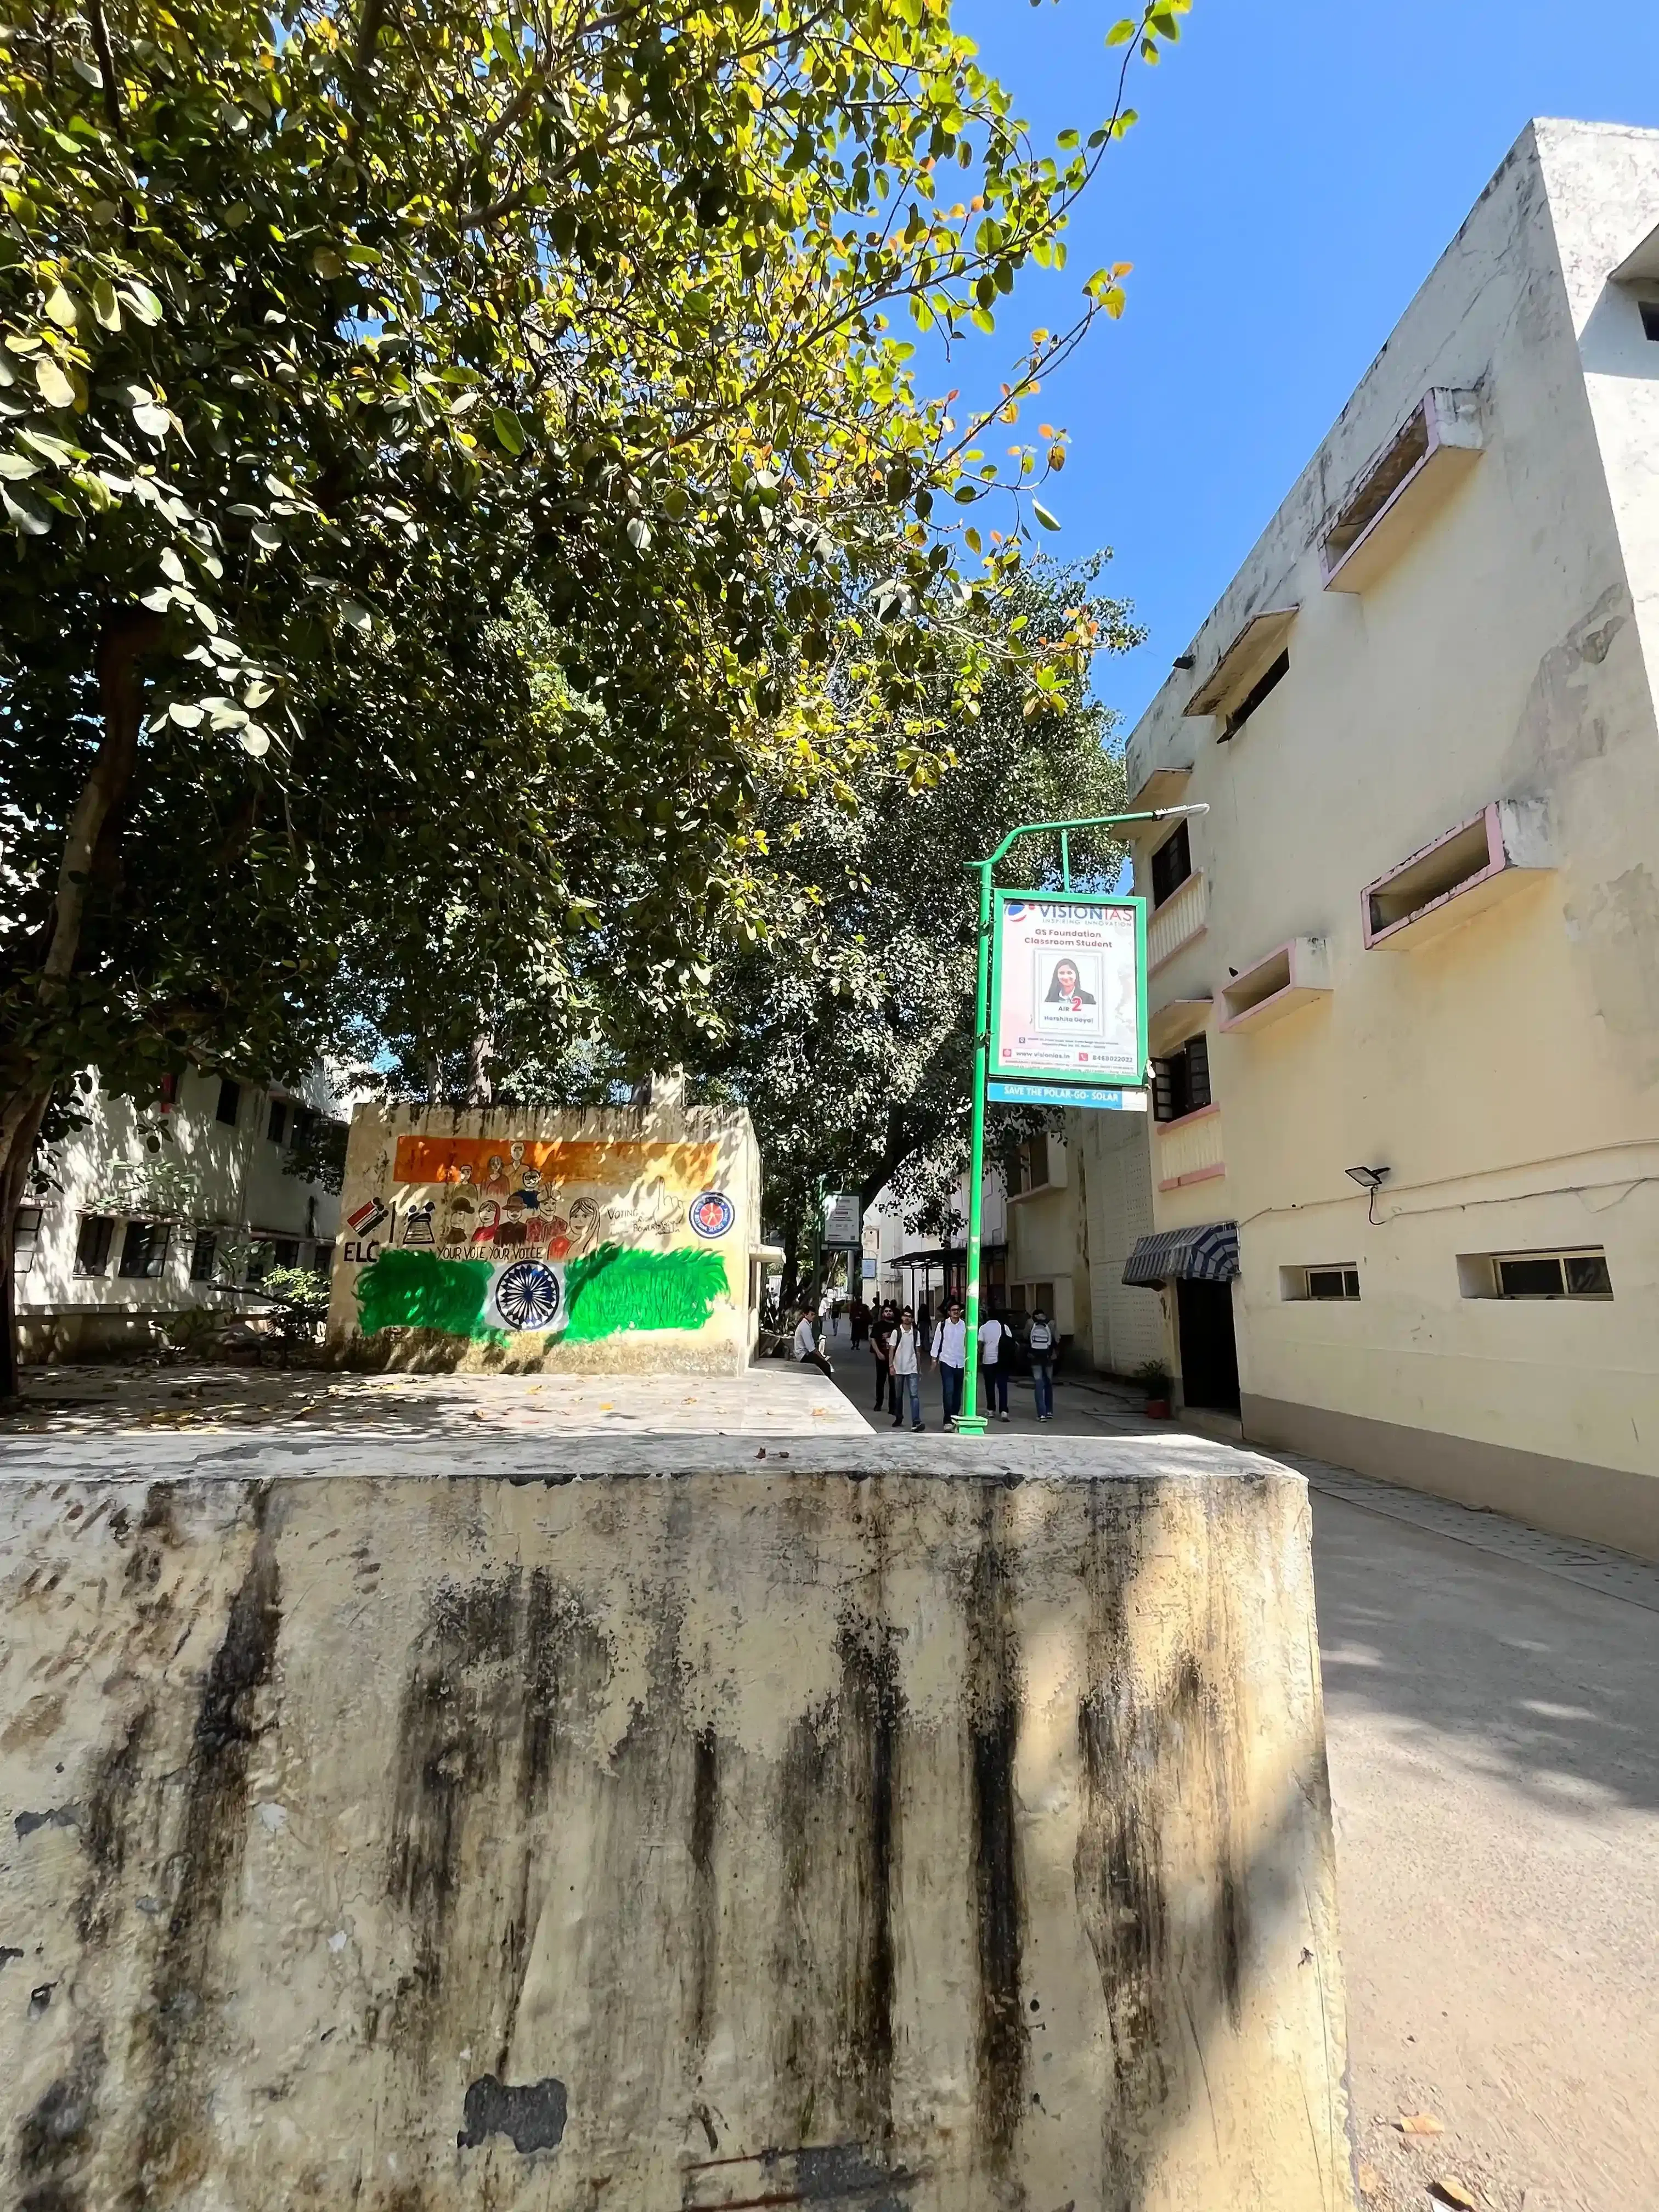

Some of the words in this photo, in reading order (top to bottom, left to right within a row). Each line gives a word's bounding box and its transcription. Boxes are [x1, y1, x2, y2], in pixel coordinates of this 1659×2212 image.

[1039, 904, 1132, 921] VISIONIAS
[1048, 929, 1102, 938] Foundation
[1024, 937, 1074, 946] Classroom
[1076, 939, 1113, 948] Student
[1071, 996, 1082, 1012] 2
[1004, 1086, 1024, 1095] SAVE
[1026, 1087, 1042, 1096] THE
[1091, 1092, 1119, 1102] SOLAR
[607, 1208, 639, 1220] VOTING
[343, 1241, 379, 1263] ELC
[437, 1246, 461, 1260] YOUR
[489, 1246, 510, 1260] YOUR
[513, 1246, 543, 1260] VOICE
